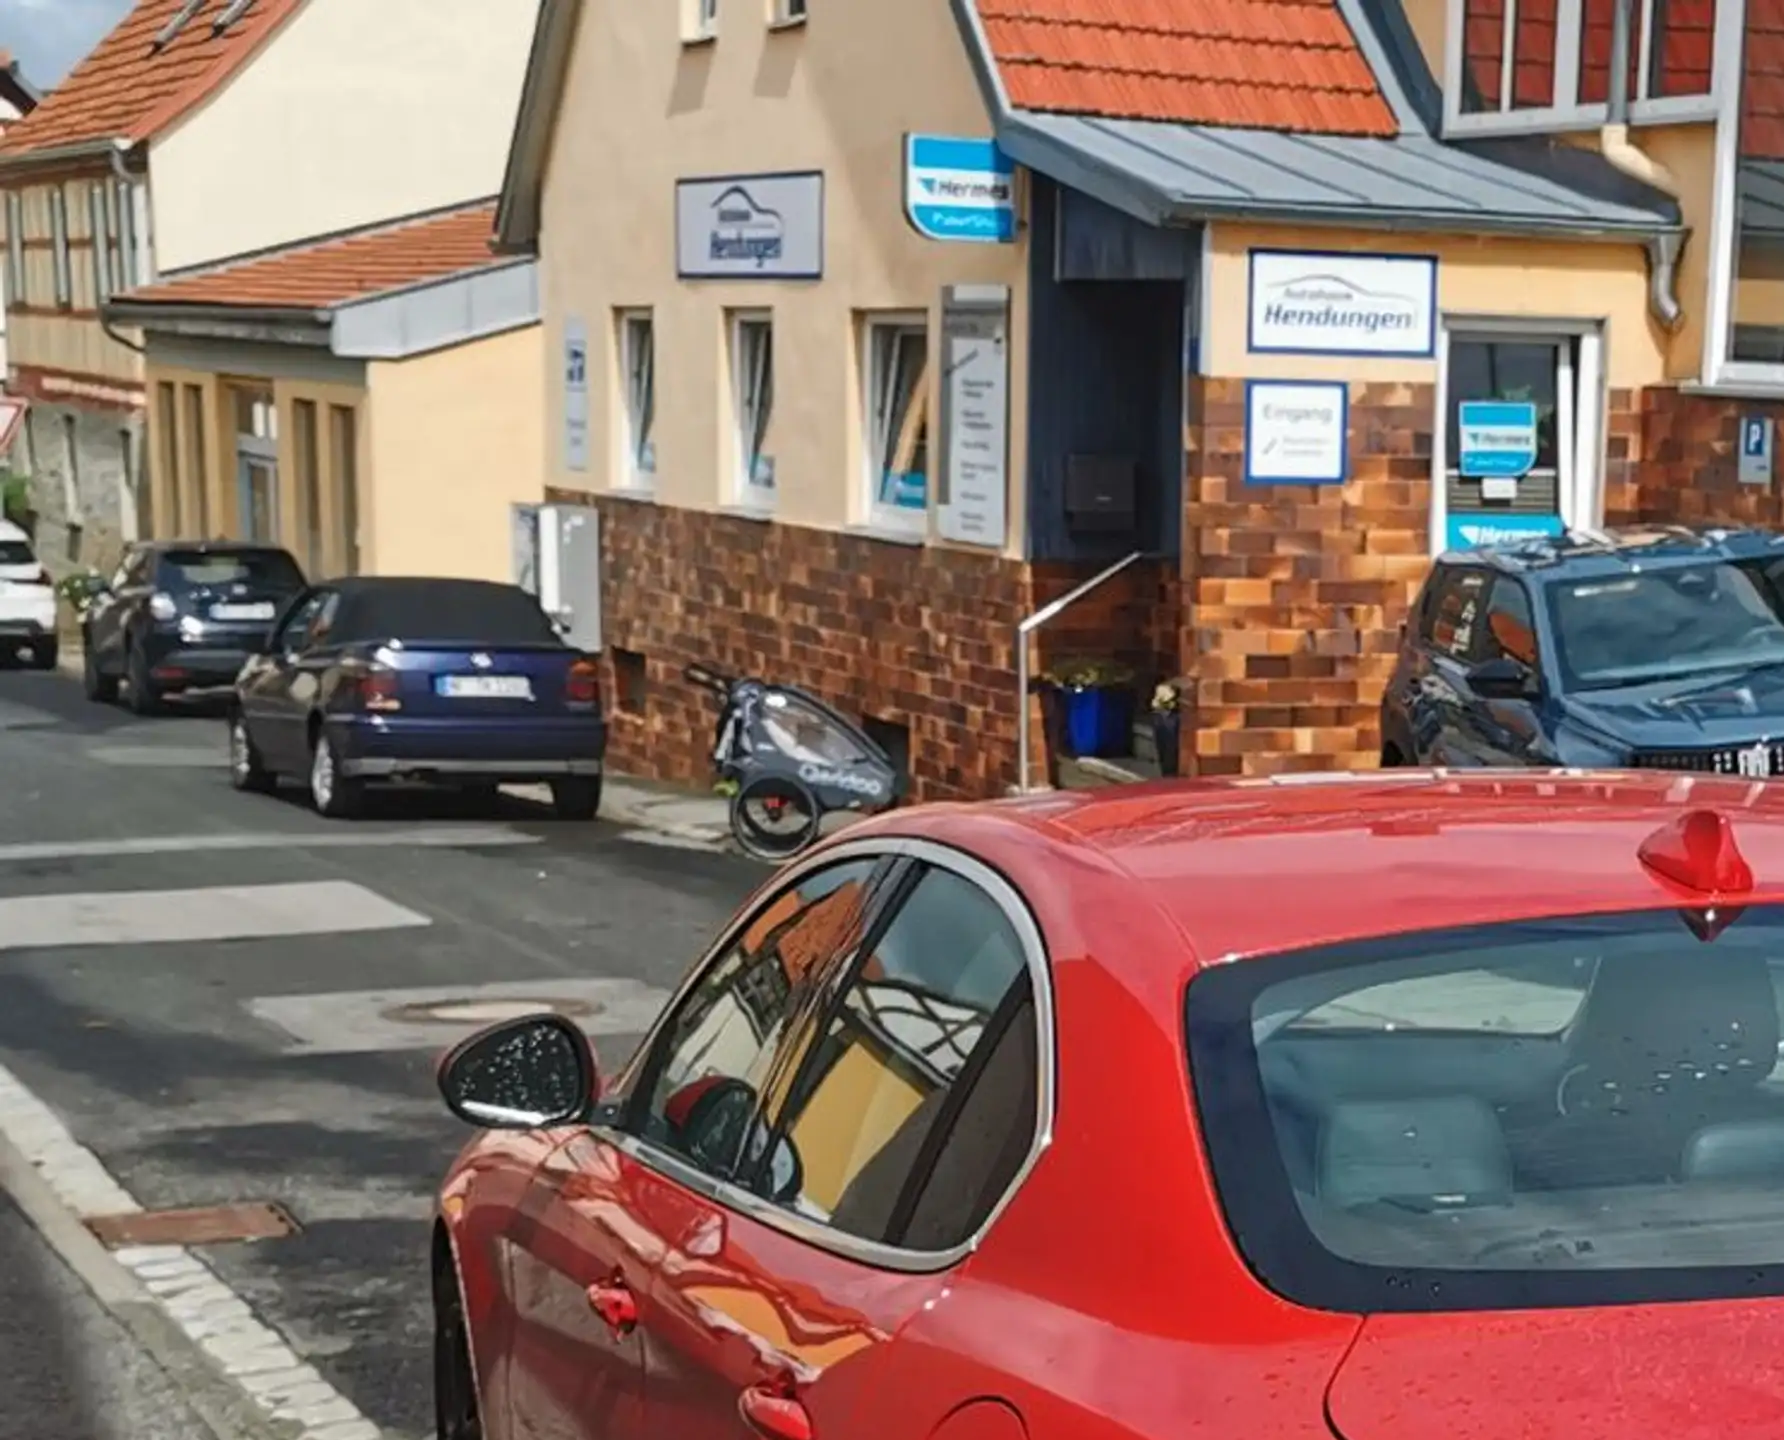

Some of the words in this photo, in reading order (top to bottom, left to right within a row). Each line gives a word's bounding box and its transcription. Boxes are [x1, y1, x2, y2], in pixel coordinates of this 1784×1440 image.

[939, 180, 1009, 200] Hermes
[1264, 303, 1412, 334] Hendungen
[1262, 403, 1333, 427] Eingang
